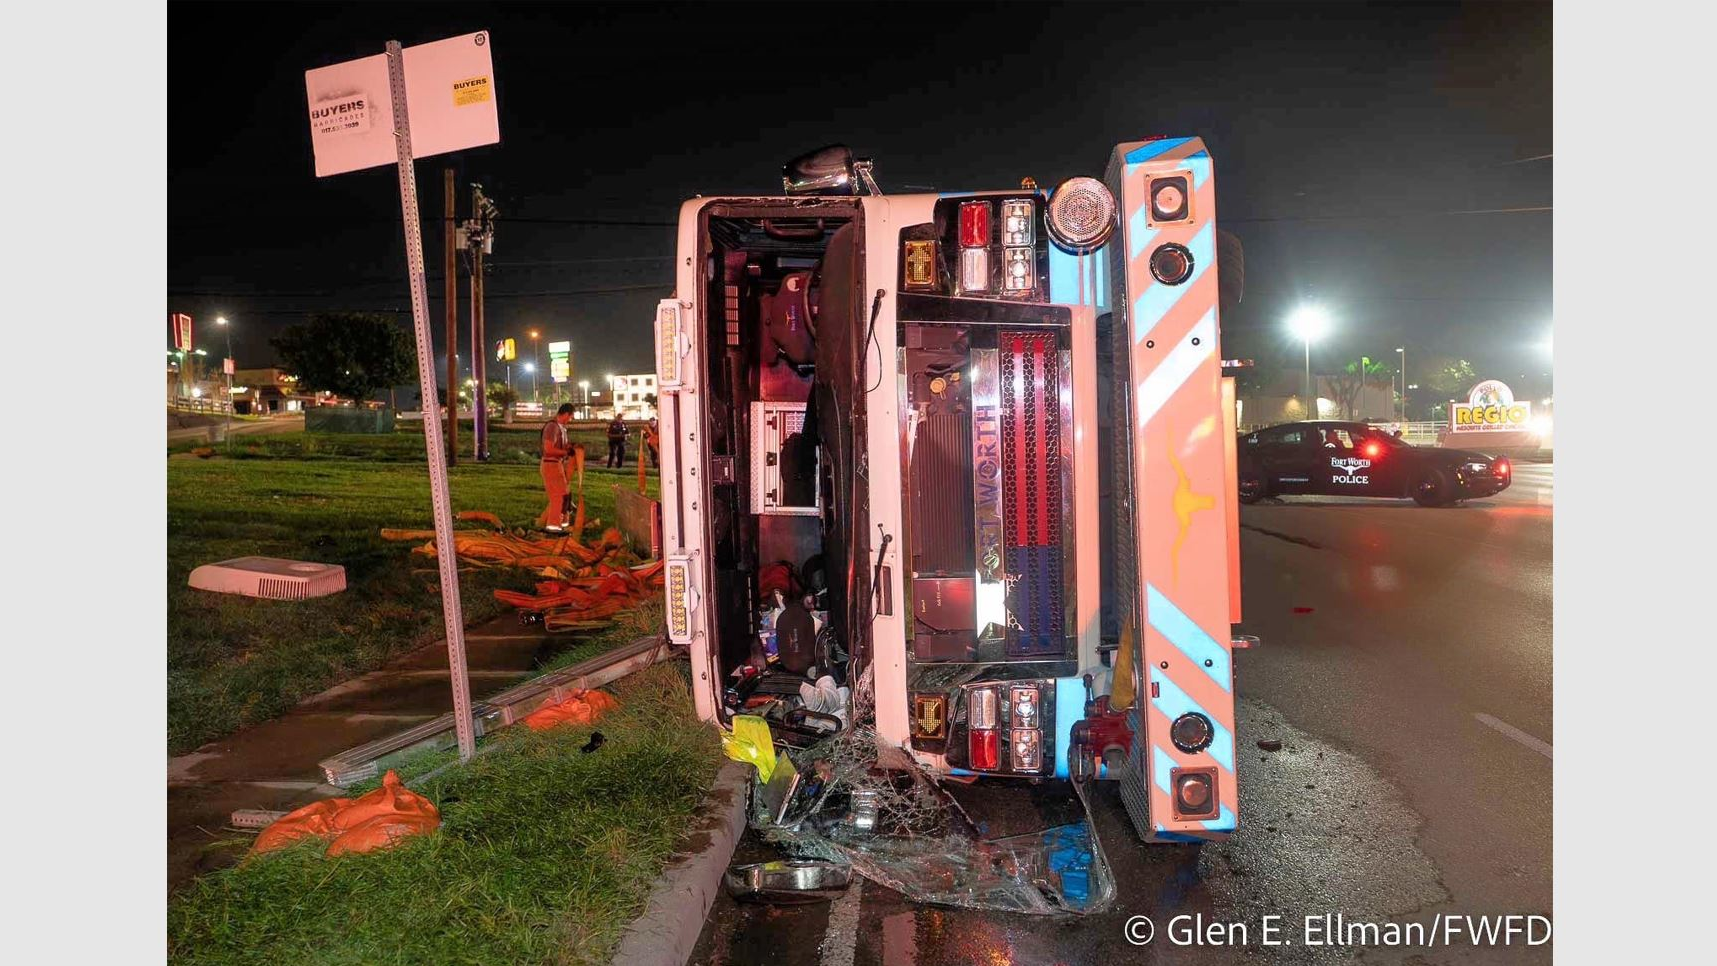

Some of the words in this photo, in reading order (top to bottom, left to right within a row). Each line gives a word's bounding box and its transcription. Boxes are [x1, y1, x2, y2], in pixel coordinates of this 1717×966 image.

[453, 78, 487, 90] BUYERS
[311, 100, 364, 119] BUYERS
[1455, 405, 1528, 425] REGIO
[976, 405, 999, 504] WORTH
[1331, 457, 1347, 466] FORT
[1347, 457, 1371, 467] WORTH
[1332, 475, 1369, 484] POLICE
